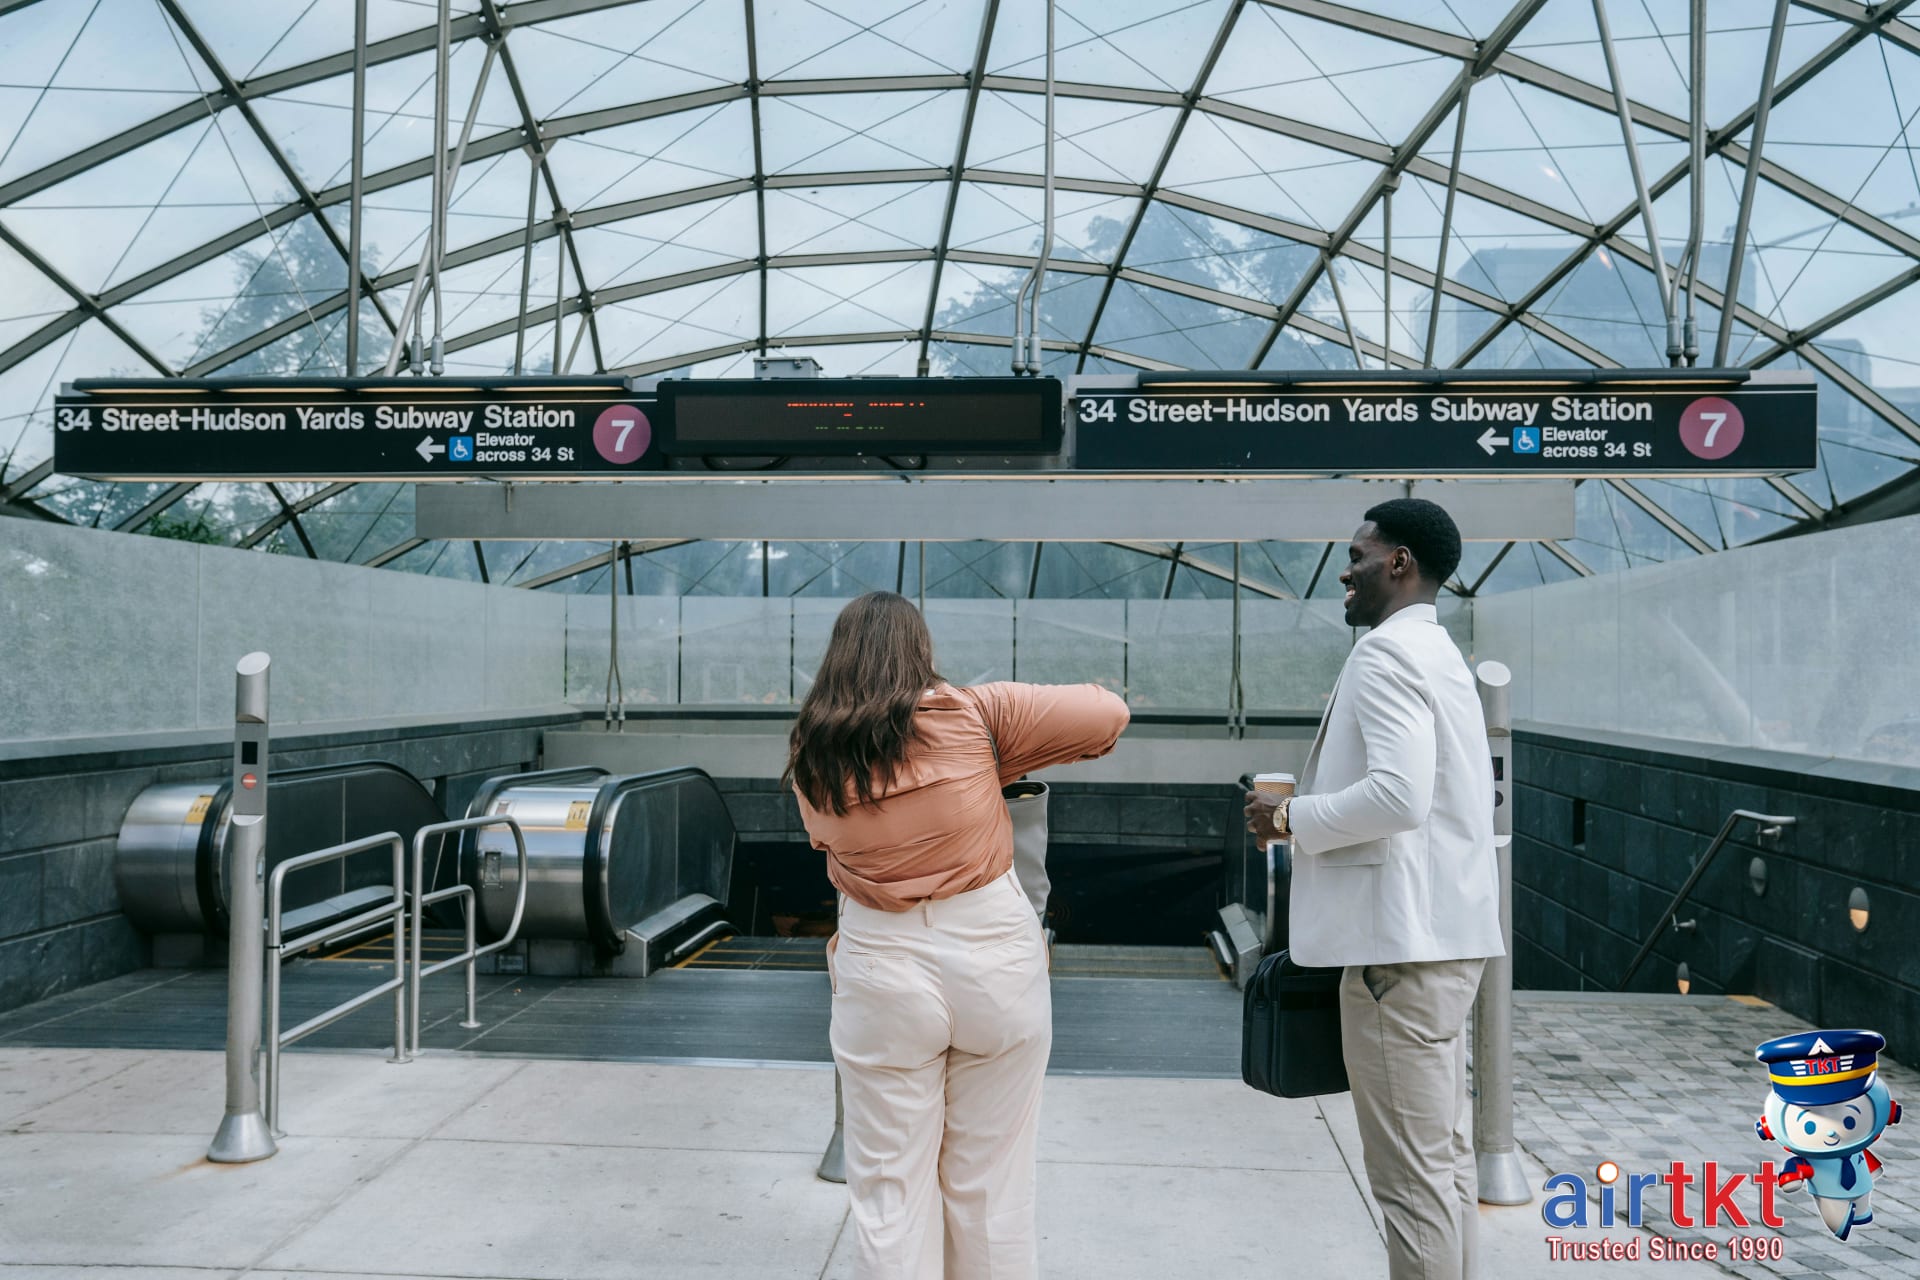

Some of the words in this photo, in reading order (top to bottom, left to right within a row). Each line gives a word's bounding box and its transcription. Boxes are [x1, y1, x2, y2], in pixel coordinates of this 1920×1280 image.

[57, 408, 92, 432] 34
[101, 407, 286, 432] Street-Hudson
[295, 406, 365, 430] Yards
[375, 405, 474, 433] Subway
[483, 404, 575, 429] Station
[1079, 398, 1117, 423] 34
[1127, 398, 1330, 423] Street-Hudson
[1342, 398, 1419, 422] Yards
[1430, 397, 1540, 426] Subway
[1551, 397, 1652, 422] Station
[475, 432, 536, 447] Elevator
[611, 419, 635, 452] 7
[1542, 426, 1609, 441] Elevator
[1700, 412, 1726, 448] 7
[475, 450, 526, 462] across
[531, 447, 552, 462] 34
[557, 446, 575, 462] St
[1542, 445, 1598, 458] across
[1604, 442, 1627, 458] 34
[1632, 441, 1652, 458] St
